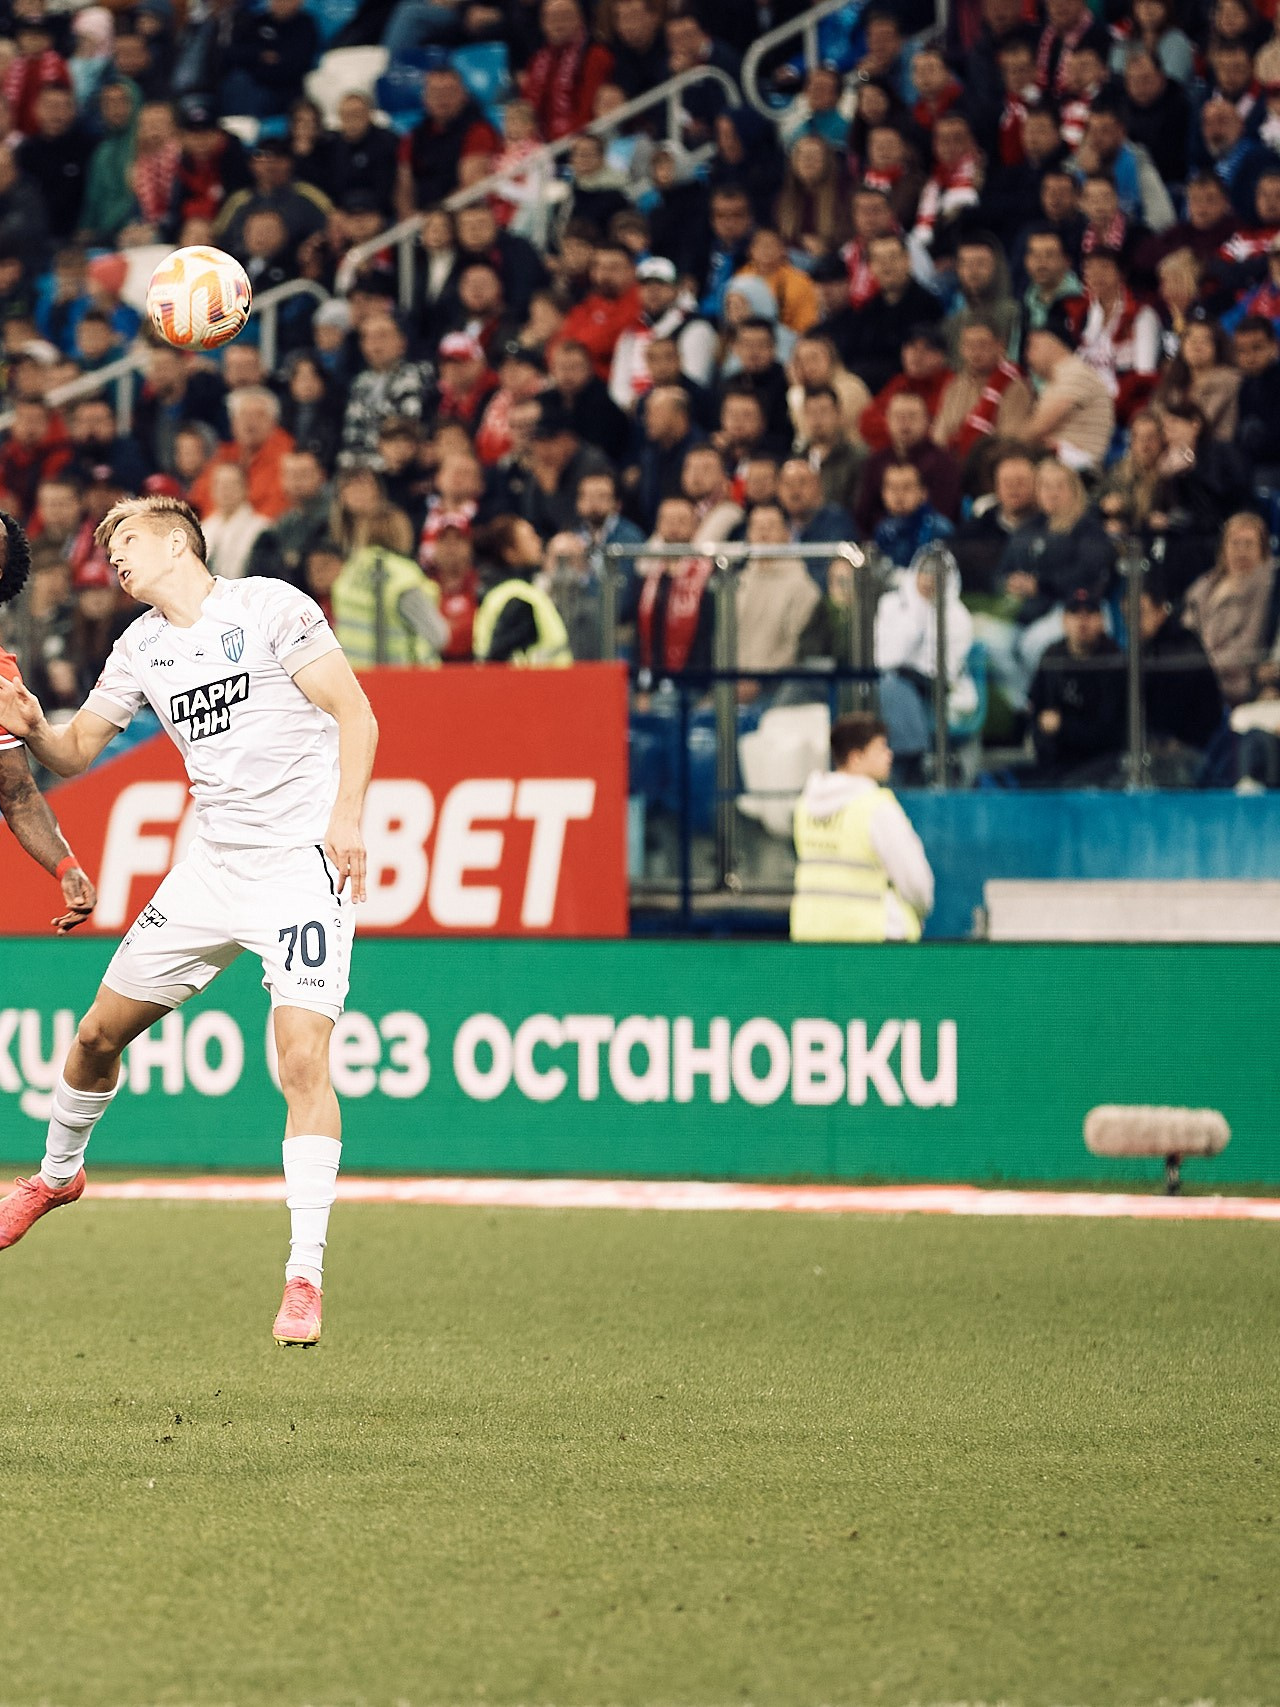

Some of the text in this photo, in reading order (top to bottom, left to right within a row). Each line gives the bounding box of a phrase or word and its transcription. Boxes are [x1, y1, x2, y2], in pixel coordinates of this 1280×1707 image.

[150, 658, 175, 668] JAKO
[171, 675, 247, 721] ПАРИ
[192, 707, 229, 739] НН
[92, 779, 597, 929] FBET
[278, 920, 327, 972] 70
[297, 977, 326, 988] JAKO
[265, 1009, 431, 1099] ез
